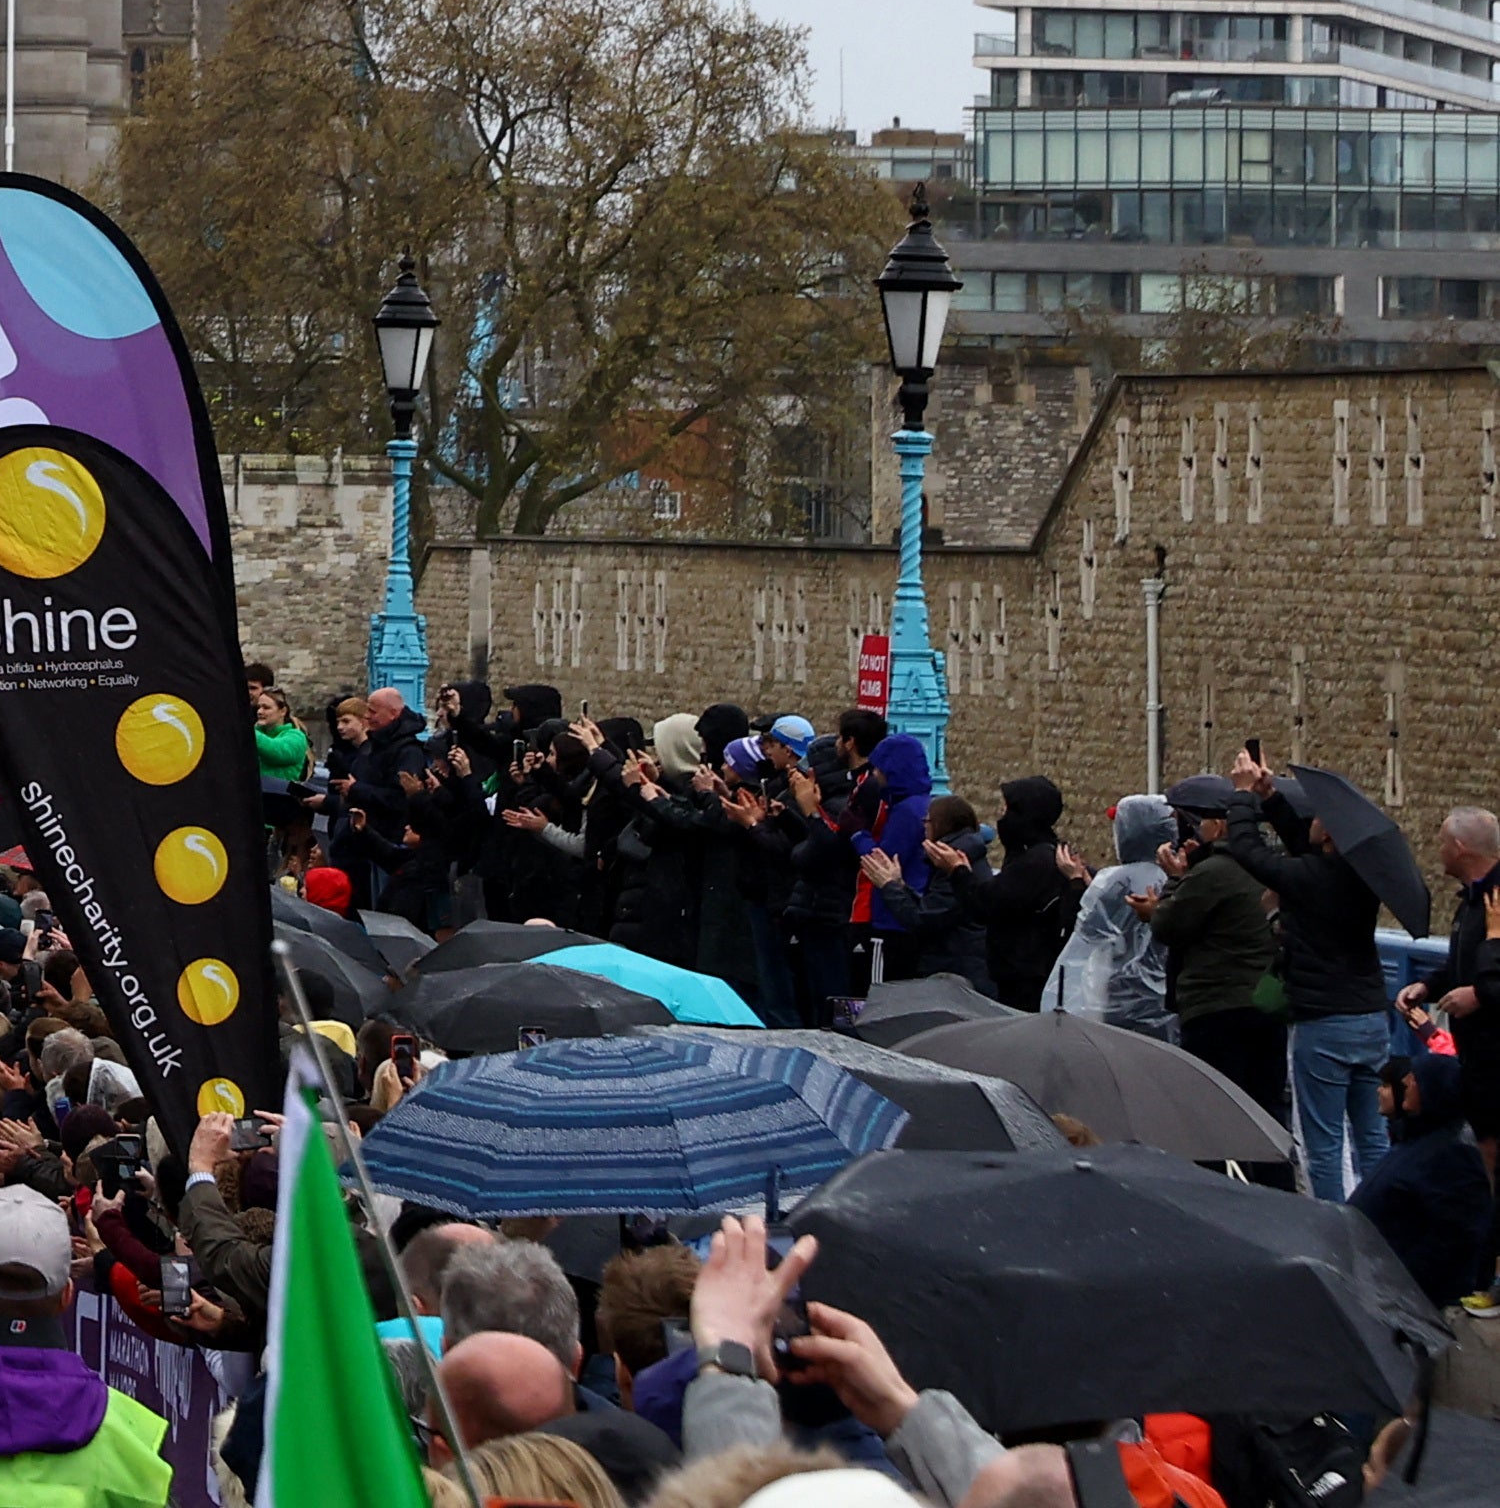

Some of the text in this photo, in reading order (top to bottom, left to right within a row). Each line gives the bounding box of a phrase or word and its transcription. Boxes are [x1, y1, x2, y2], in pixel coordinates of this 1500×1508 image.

[5, 661, 35, 674] bifida
[45, 658, 124, 674] Hydrocephalus
[869, 654, 887, 672] NOT
[28, 676, 88, 690] Networking
[98, 673, 140, 688] Equality
[21, 781, 183, 1079] shinecharity.org.uk
